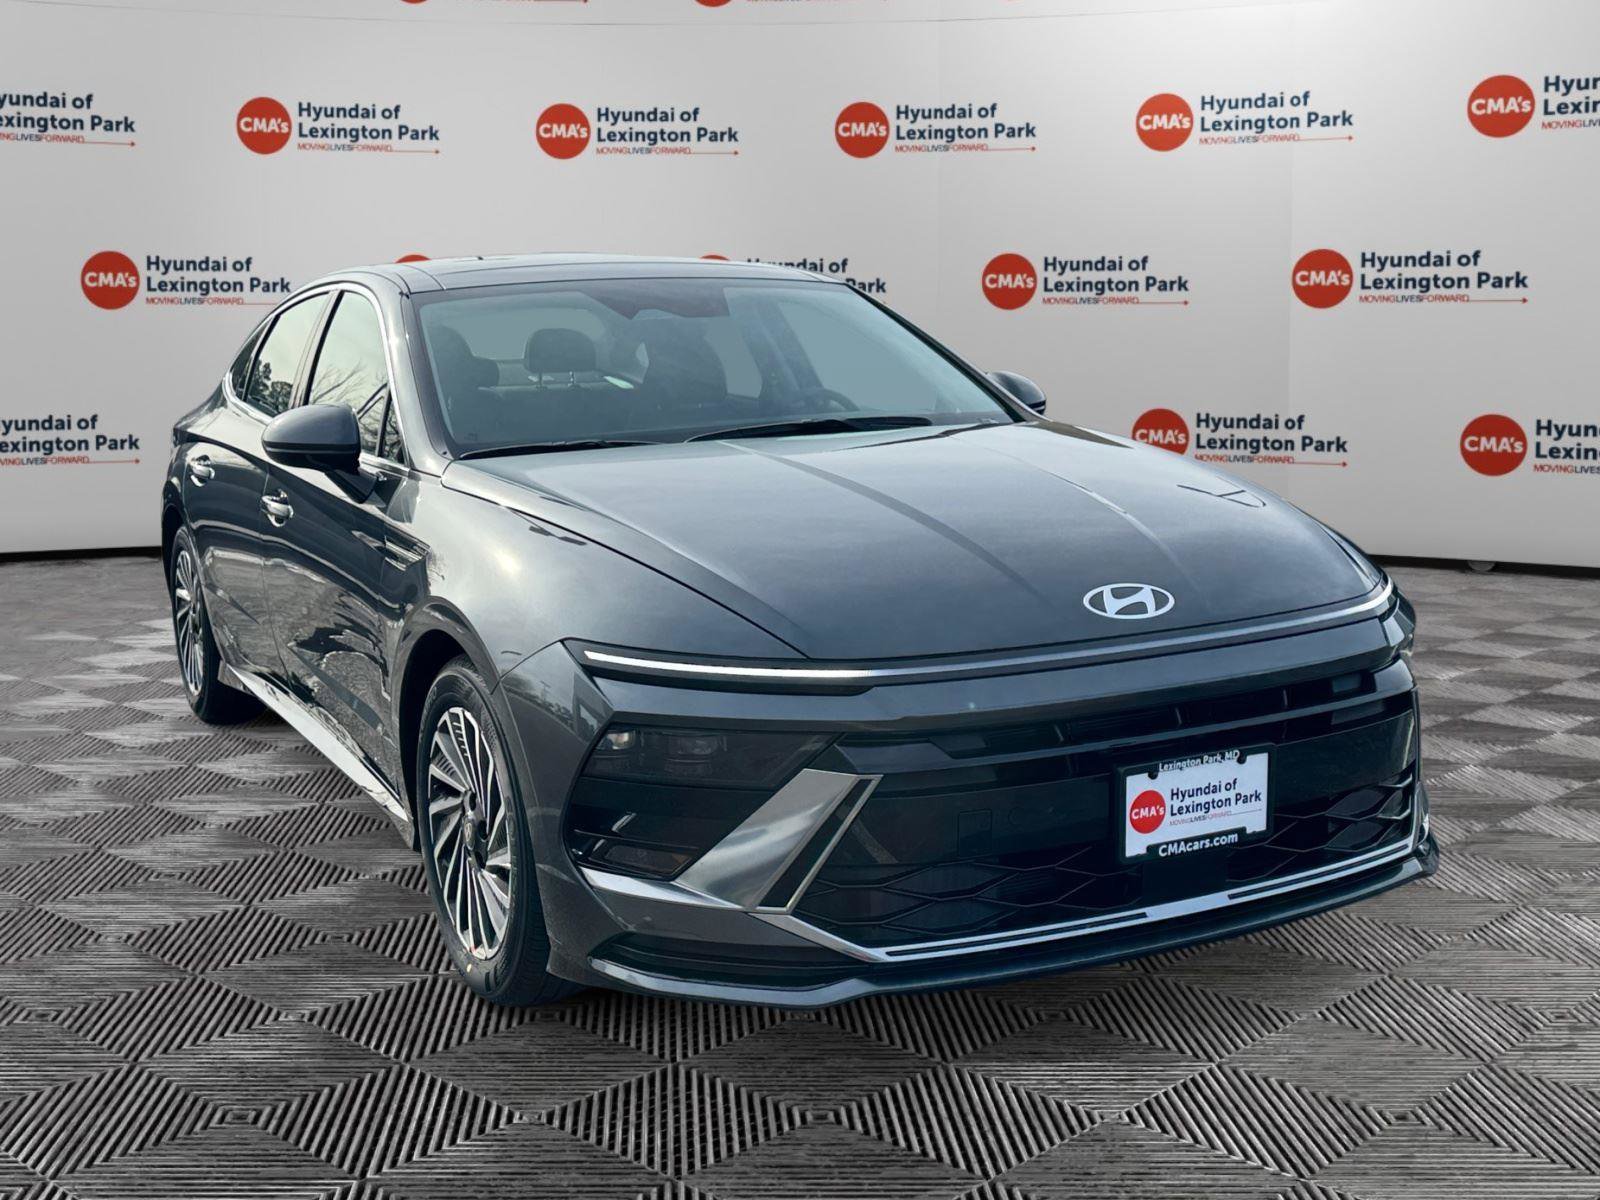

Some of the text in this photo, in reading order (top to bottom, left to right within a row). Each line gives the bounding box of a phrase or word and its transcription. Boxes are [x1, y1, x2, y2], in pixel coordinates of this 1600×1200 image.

[1544, 75, 1600, 97] Hyun
[0, 92, 94, 110] yundai of
[1201, 91, 1310, 114] Hyundai of
[1471, 96, 1531, 115] CMA's
[1544, 96, 1600, 116] Lexin
[299, 102, 401, 122] Hyundai of
[597, 107, 700, 127] Hyundai of
[896, 103, 997, 124] Hyundai of
[1139, 112, 1191, 131] CMA's
[1201, 110, 1353, 134] Lexington Park
[0, 112, 136, 133] xington Park
[240, 116, 289, 133] CMA's
[299, 122, 440, 143] Lexington Park
[539, 123, 588, 138] CMA's
[838, 122, 887, 137] CMA's
[597, 127, 739, 146] Lexington Park
[896, 123, 1036, 143] Lexington Park
[147, 255, 253, 275] Hyundai of
[828, 258, 849, 273] of
[1044, 256, 1148, 276] Hyundai of
[1361, 250, 1481, 272] Hyundai of
[84, 272, 137, 288] CMA's
[147, 275, 290, 296] Lexington Park
[985, 272, 1034, 289] CMA's
[1044, 276, 1189, 296] Lexington Park
[1295, 269, 1350, 286] CMA's
[1361, 271, 1529, 293] Lexington Park
[0, 414, 98, 436] yundai of
[1196, 413, 1305, 433] Hyundai of
[1536, 419, 1600, 441] Hyun
[0, 434, 140, 456] exington Park
[1196, 433, 1348, 454] Lexington Park
[1464, 435, 1524, 453] CMA's
[1536, 442, 1600, 460] Lexin
[1159, 758, 1202, 772] Lexington
[1225, 749, 1240, 761] MD
[1171, 778, 1238, 803] Hyundai of
[1131, 805, 1165, 820] CMA's
[1170, 789, 1262, 818] Lexington Park
[1158, 831, 1239, 857] CMAcars.com
